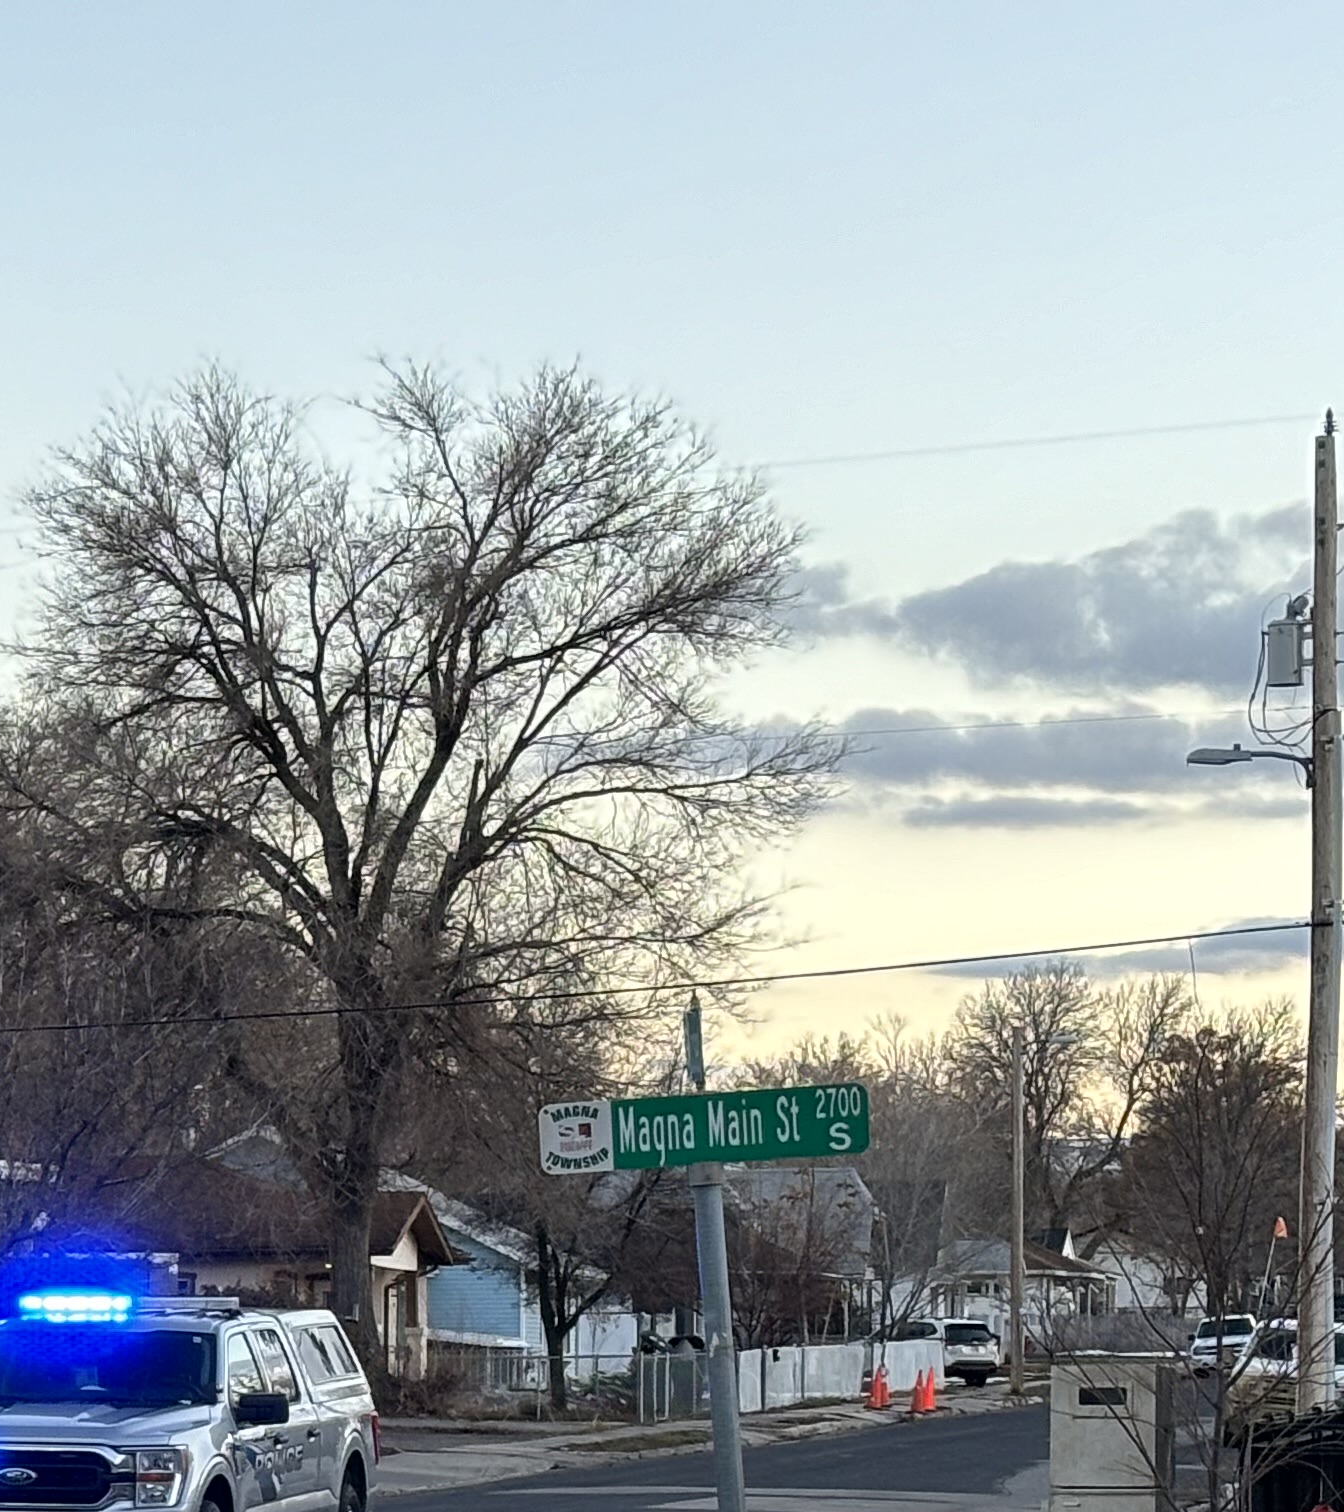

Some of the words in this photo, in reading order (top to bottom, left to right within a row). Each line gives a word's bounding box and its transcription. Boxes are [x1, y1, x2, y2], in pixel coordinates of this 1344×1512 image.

[549, 1105, 600, 1123] MAGNA
[618, 1105, 695, 1167] Magna
[708, 1098, 764, 1148] Main
[776, 1095, 801, 1144] St
[815, 1086, 862, 1120] 2700
[828, 1122, 853, 1152] S
[545, 1147, 610, 1170] TOWNSHIP
